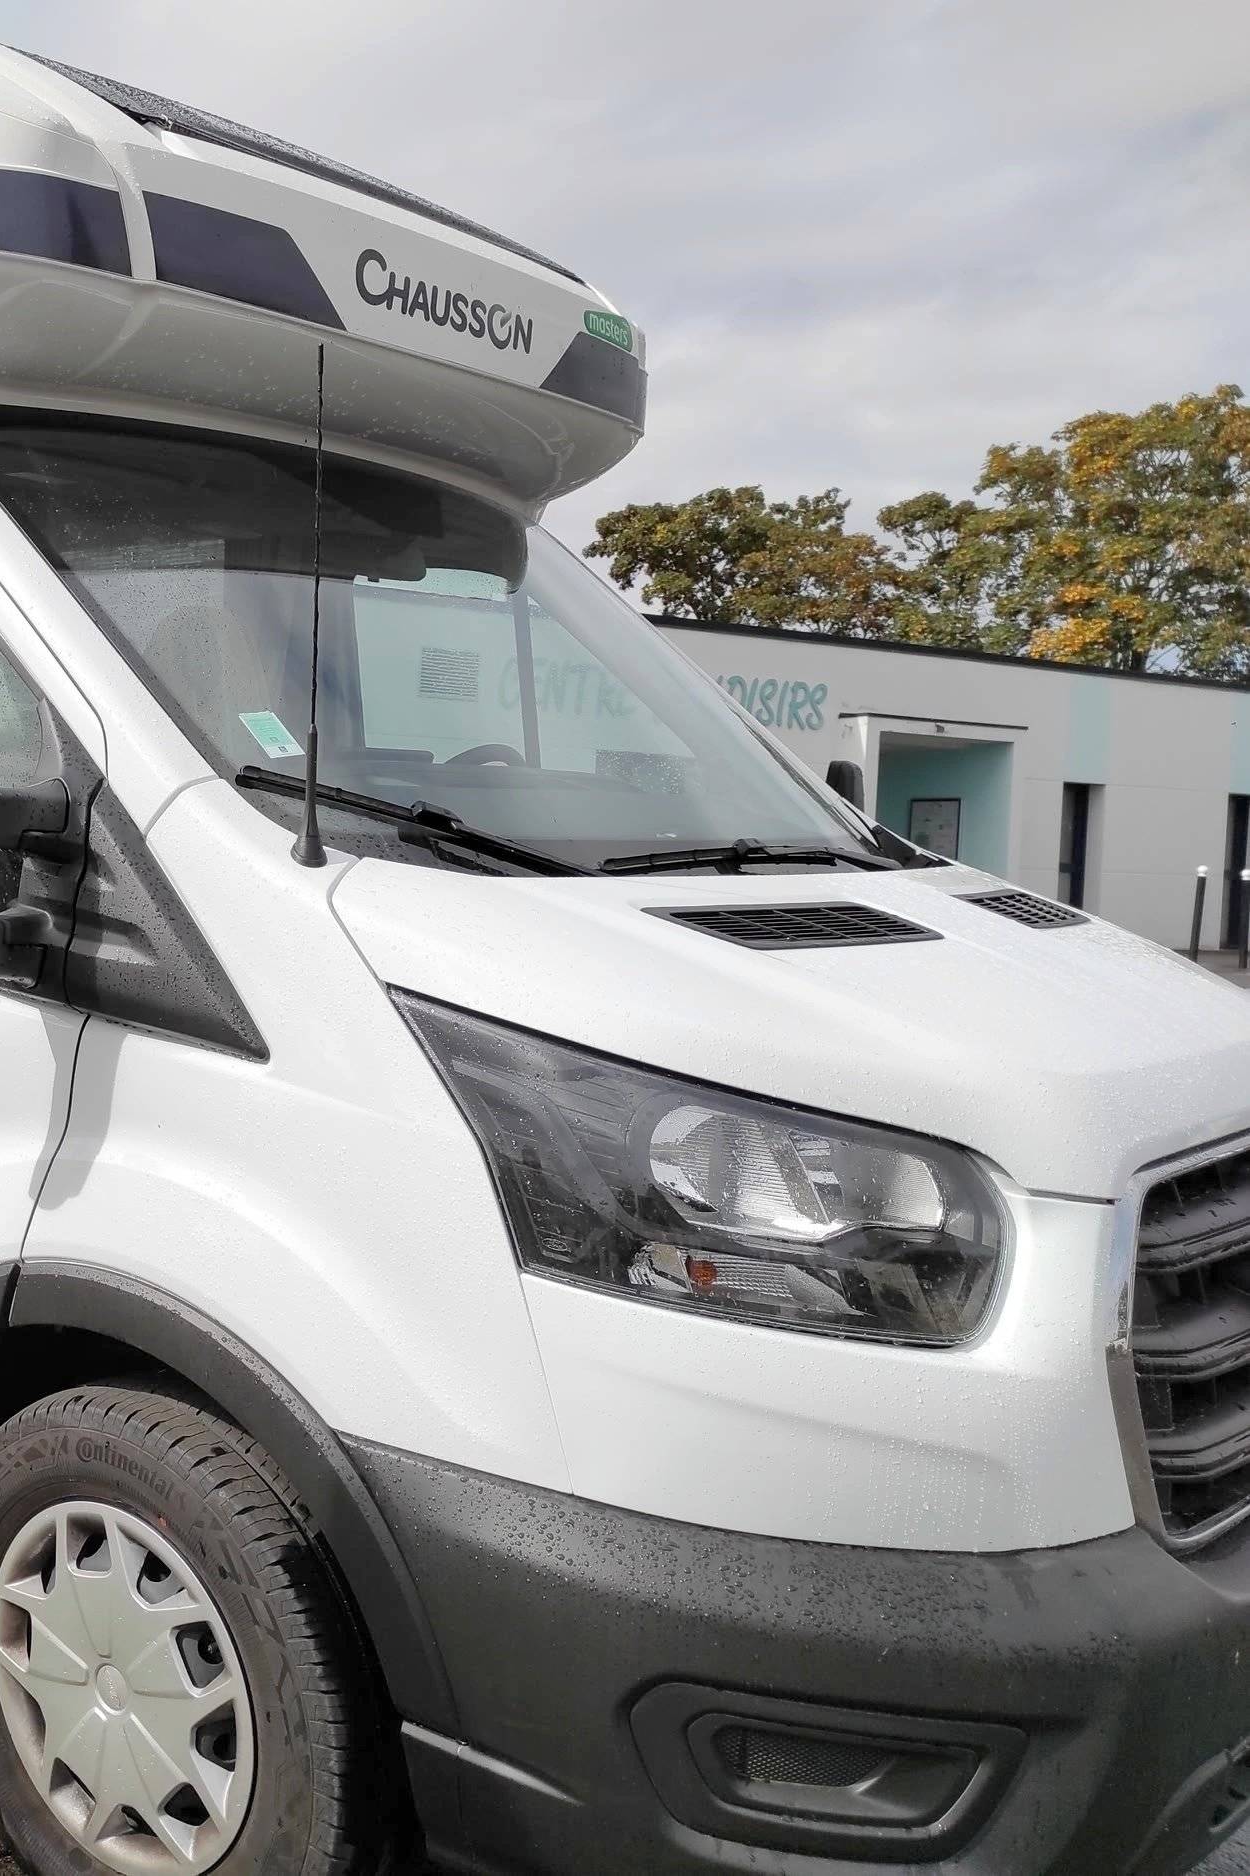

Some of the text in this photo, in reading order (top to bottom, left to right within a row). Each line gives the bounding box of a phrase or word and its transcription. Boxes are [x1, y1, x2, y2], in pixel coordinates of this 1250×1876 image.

[355, 248, 533, 354] CHAUSSON
[589, 313, 628, 346] masters
[717, 675, 829, 731] OISIRS
[75, 1437, 174, 1500] Continental
